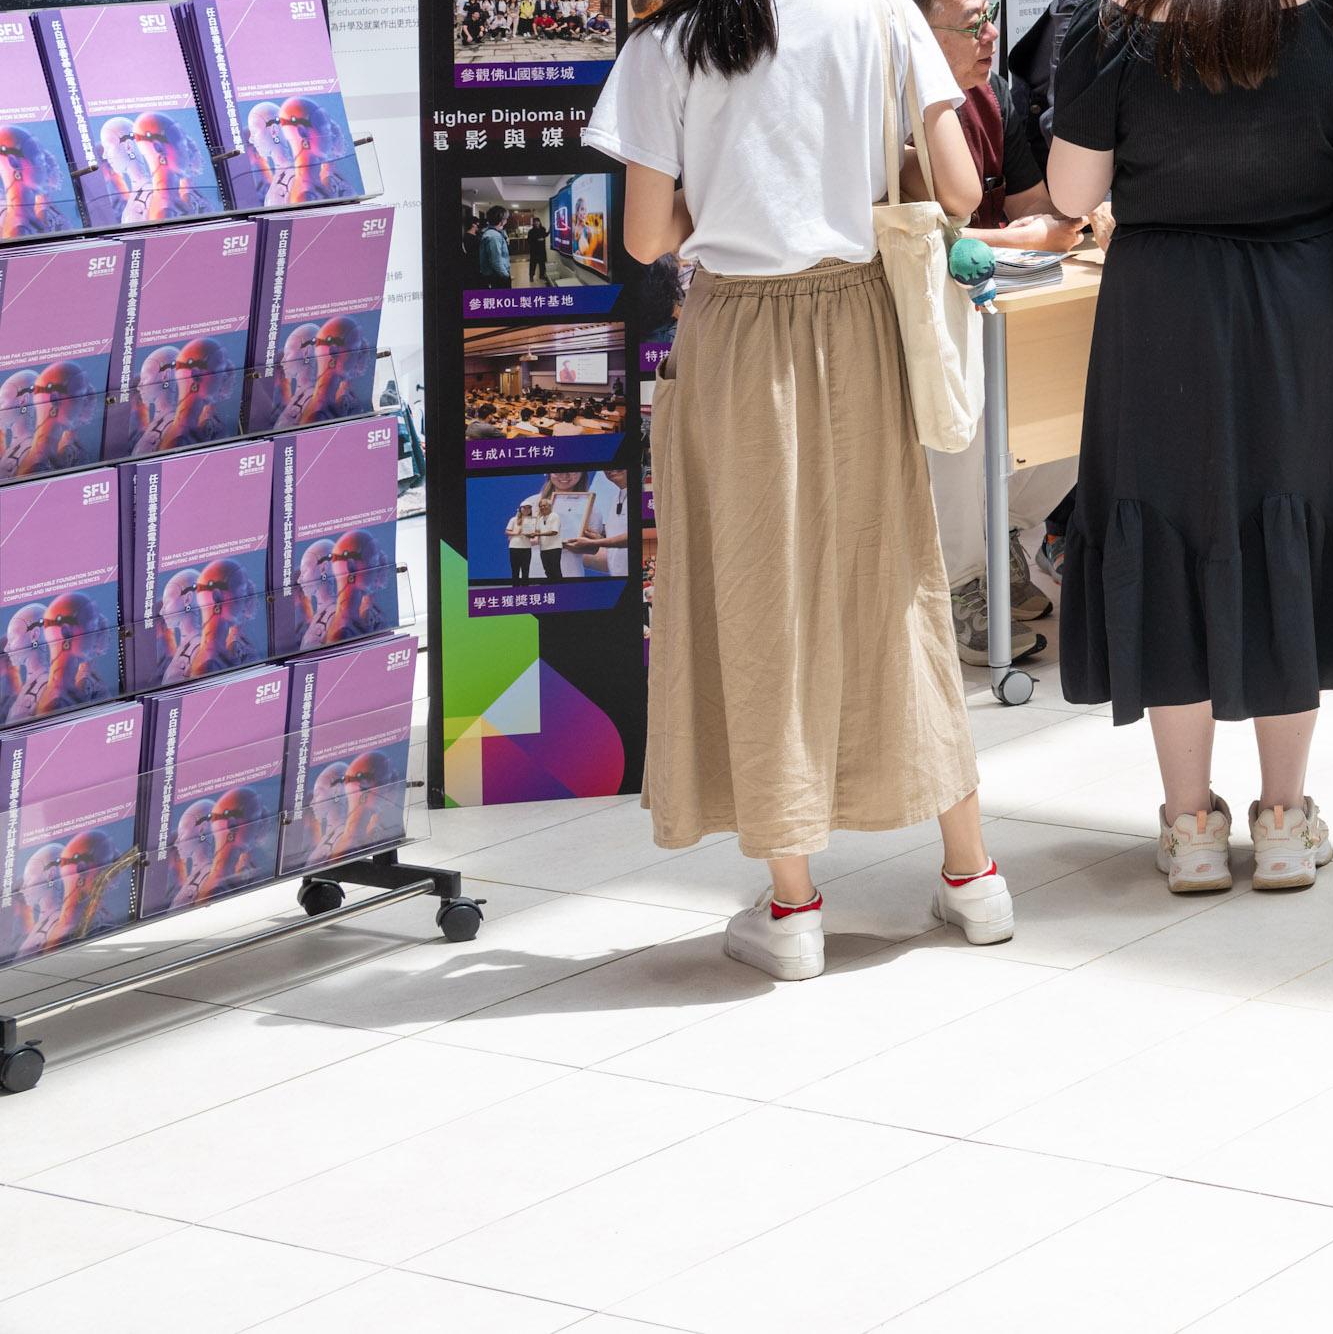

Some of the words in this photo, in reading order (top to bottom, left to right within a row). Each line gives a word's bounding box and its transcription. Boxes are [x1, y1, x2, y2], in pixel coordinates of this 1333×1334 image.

[290, 1, 315, 14] SFU
[139, 14, 166, 27] SFU
[460, 66, 575, 83] 參觀佛山國藝影城
[492, 108, 565, 126] Diploma
[570, 107, 586, 120] in
[362, 218, 387, 232] SFU
[222, 235, 249, 249] SFU
[88, 256, 116, 271] SFU
[468, 294, 574, 311] 參觀KOL製作基地
[163, 325, 190, 335] CHARITABLE
[191, 321, 219, 331] FOUNDATION
[220, 318, 238, 327] SCHOOL
[140, 334, 168, 343] COMPUTING
[367, 428, 391, 443] SFU
[471, 445, 555, 462] 生成AI工作坊
[239, 454, 266, 470] SFU
[82, 481, 110, 498] SFU
[473, 592, 557, 609] 學生獲獎現場
[387, 649, 411, 665] SFU
[106, 719, 134, 738] SFU
